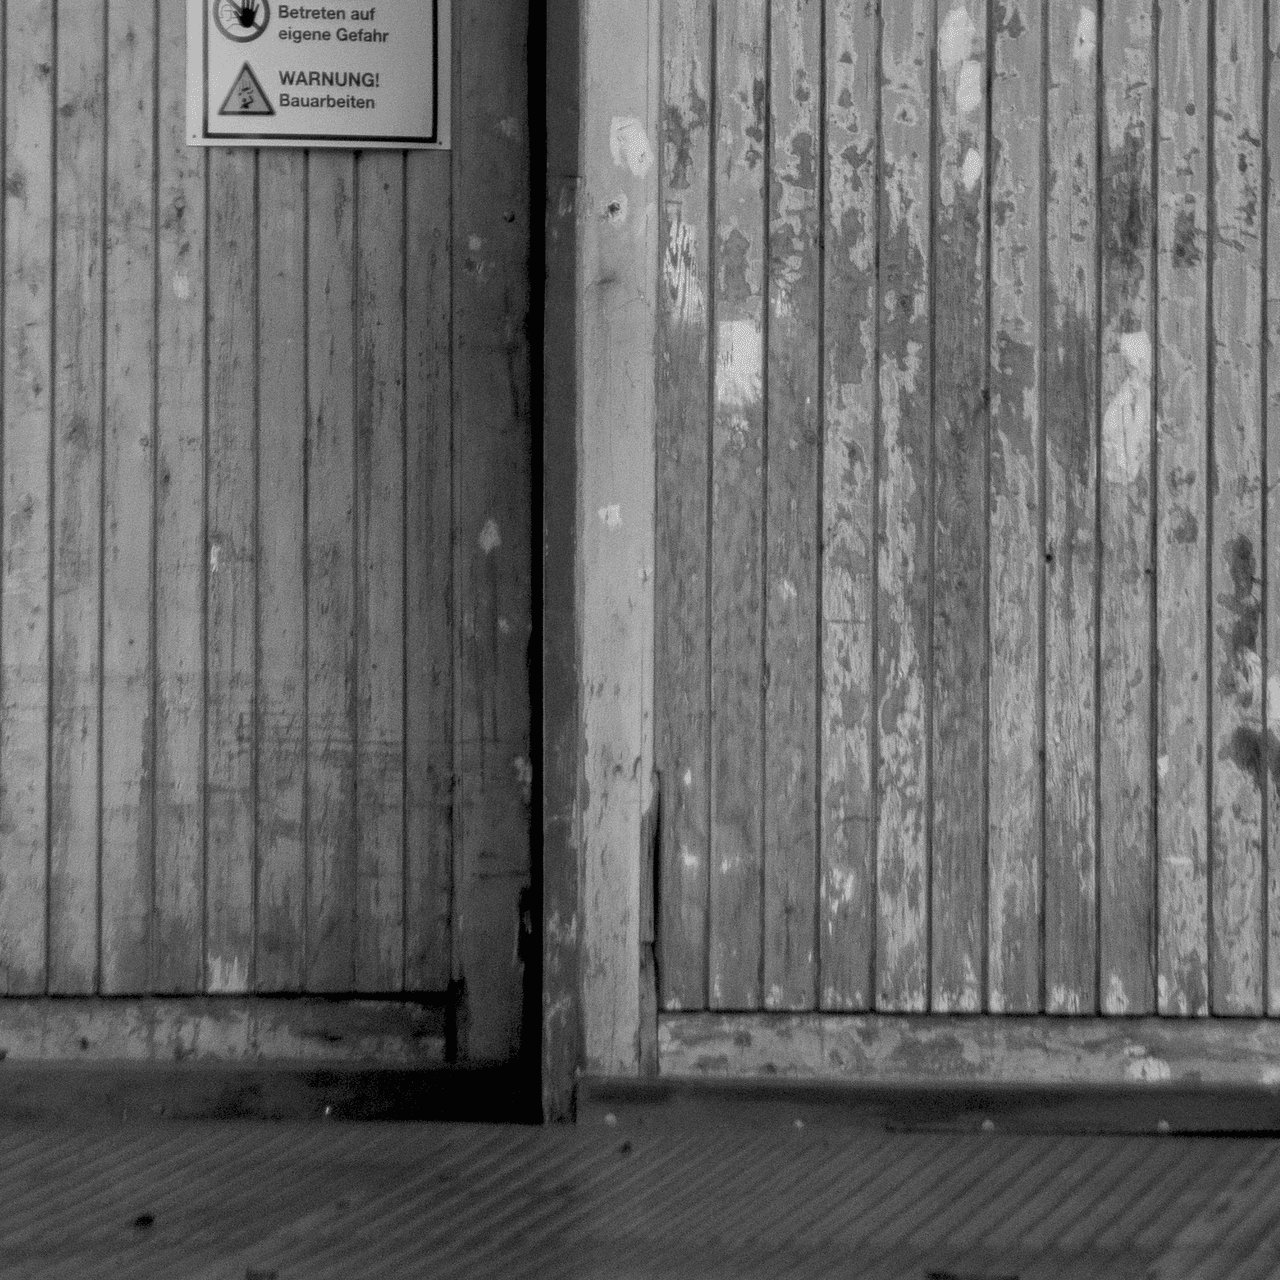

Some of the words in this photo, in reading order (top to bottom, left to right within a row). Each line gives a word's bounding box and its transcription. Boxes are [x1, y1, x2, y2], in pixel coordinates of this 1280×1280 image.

[279, 5, 345, 20] Betreten
[351, 7, 375, 20] auf
[279, 27, 331, 43] eigene
[336, 28, 389, 42] Gefahr
[279, 71, 379, 87] WARNUNG!
[280, 93, 375, 108] Bauarbeiten
